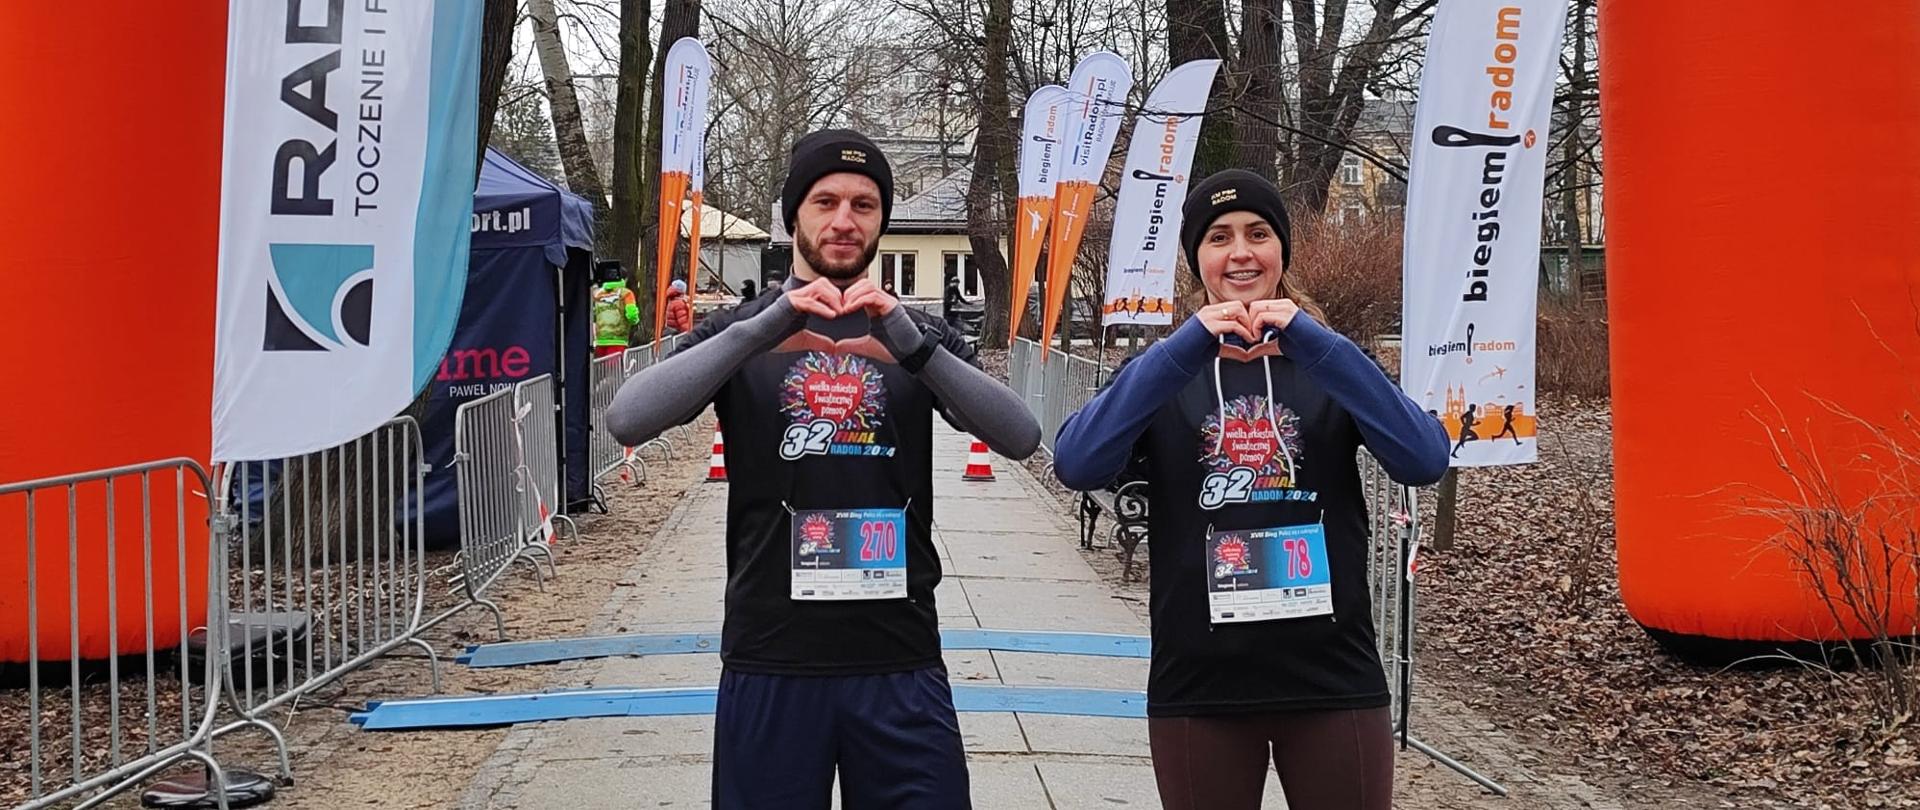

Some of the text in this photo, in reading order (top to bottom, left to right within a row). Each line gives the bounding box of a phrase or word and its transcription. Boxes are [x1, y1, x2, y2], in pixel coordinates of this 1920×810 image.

[355, 49, 385, 217] TOCZENIE
[1081, 78, 1107, 166] visitRadom.pl
[1038, 105, 1057, 183] biegiem radom
[1463, 7, 1521, 301] biegiem radom
[1142, 183, 1167, 251] biegiem
[1160, 116, 1178, 173] radom
[1429, 340, 1515, 356] biegiem radom
[780, 419, 837, 460] 32
[831, 444, 896, 457] RADOM 2024
[1199, 466, 1257, 510] 32
[1251, 489, 1318, 502] RADOM 2024
[860, 521, 897, 561] 270
[1282, 538, 1312, 579] 78
[1214, 563, 1234, 579] 32
